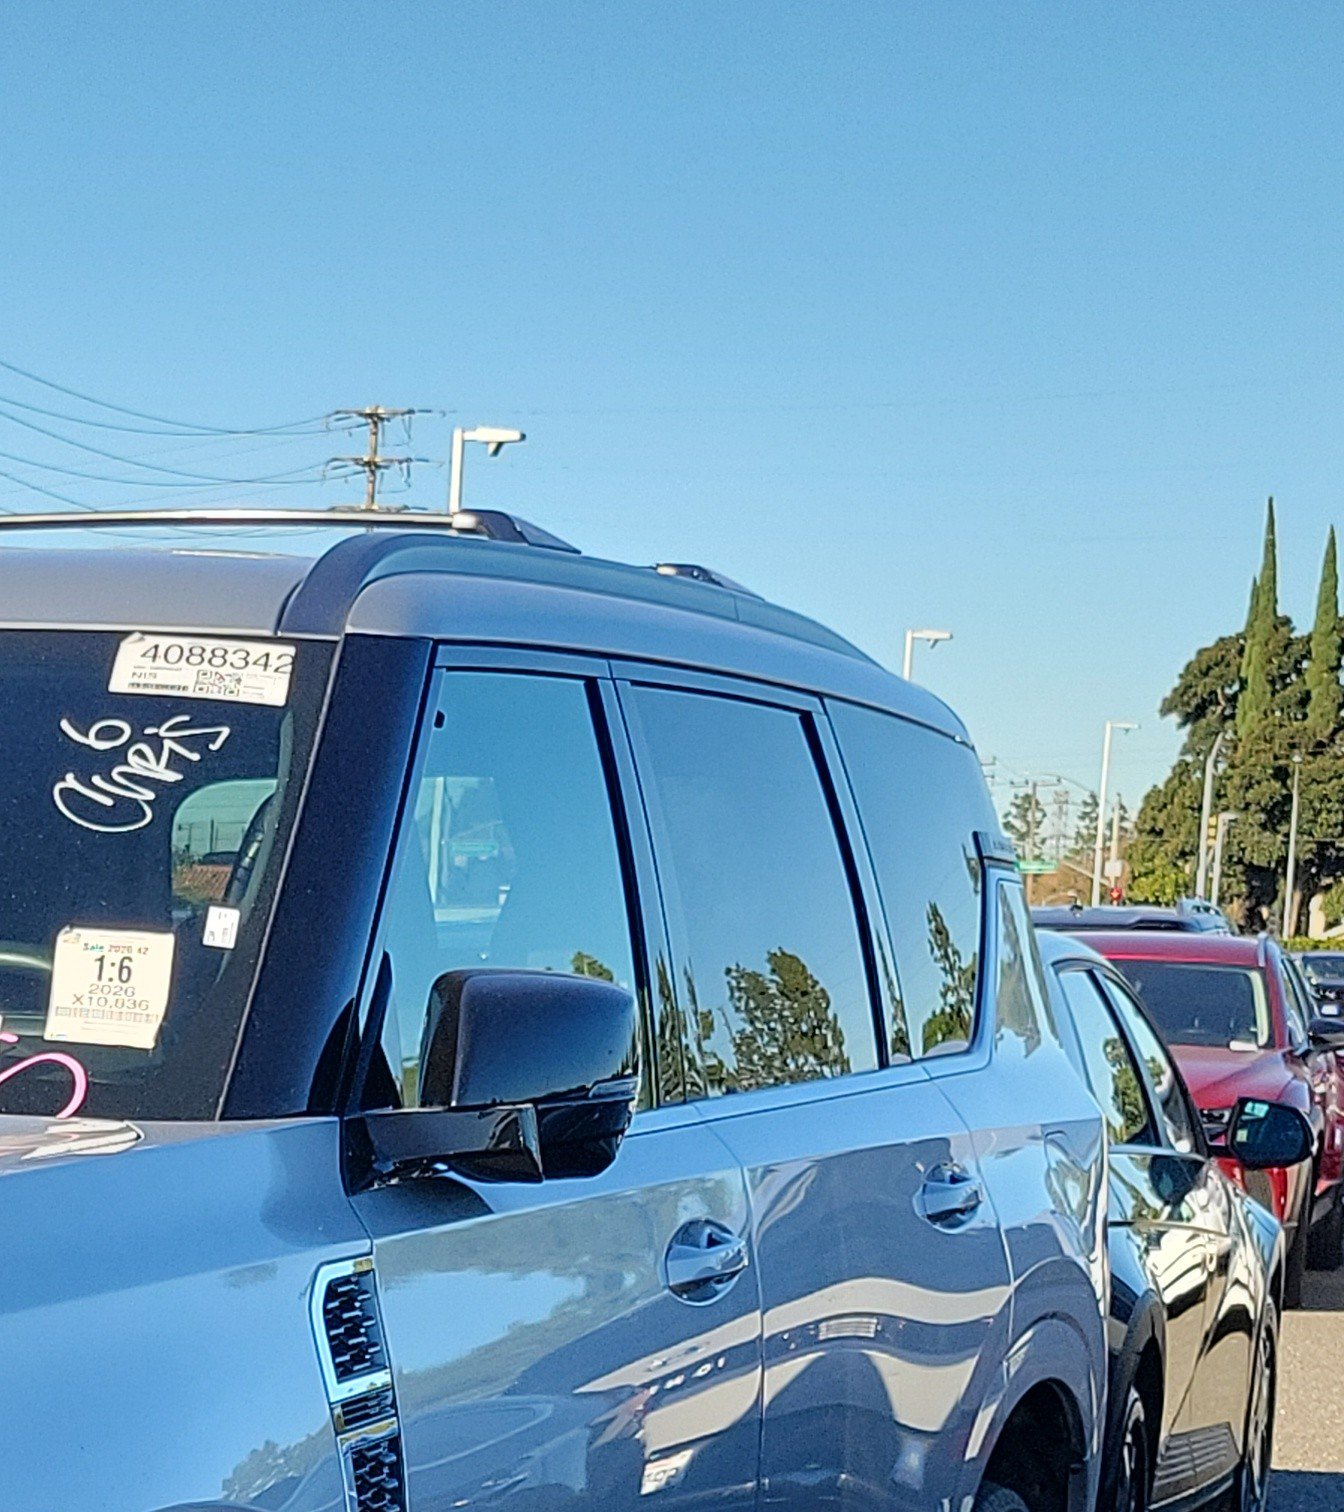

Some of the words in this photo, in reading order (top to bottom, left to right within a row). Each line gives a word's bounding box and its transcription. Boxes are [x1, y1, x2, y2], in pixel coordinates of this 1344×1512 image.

[140, 643, 295, 675] 4088342
[59, 717, 132, 751] 6
[94, 954, 133, 984] 1:6
